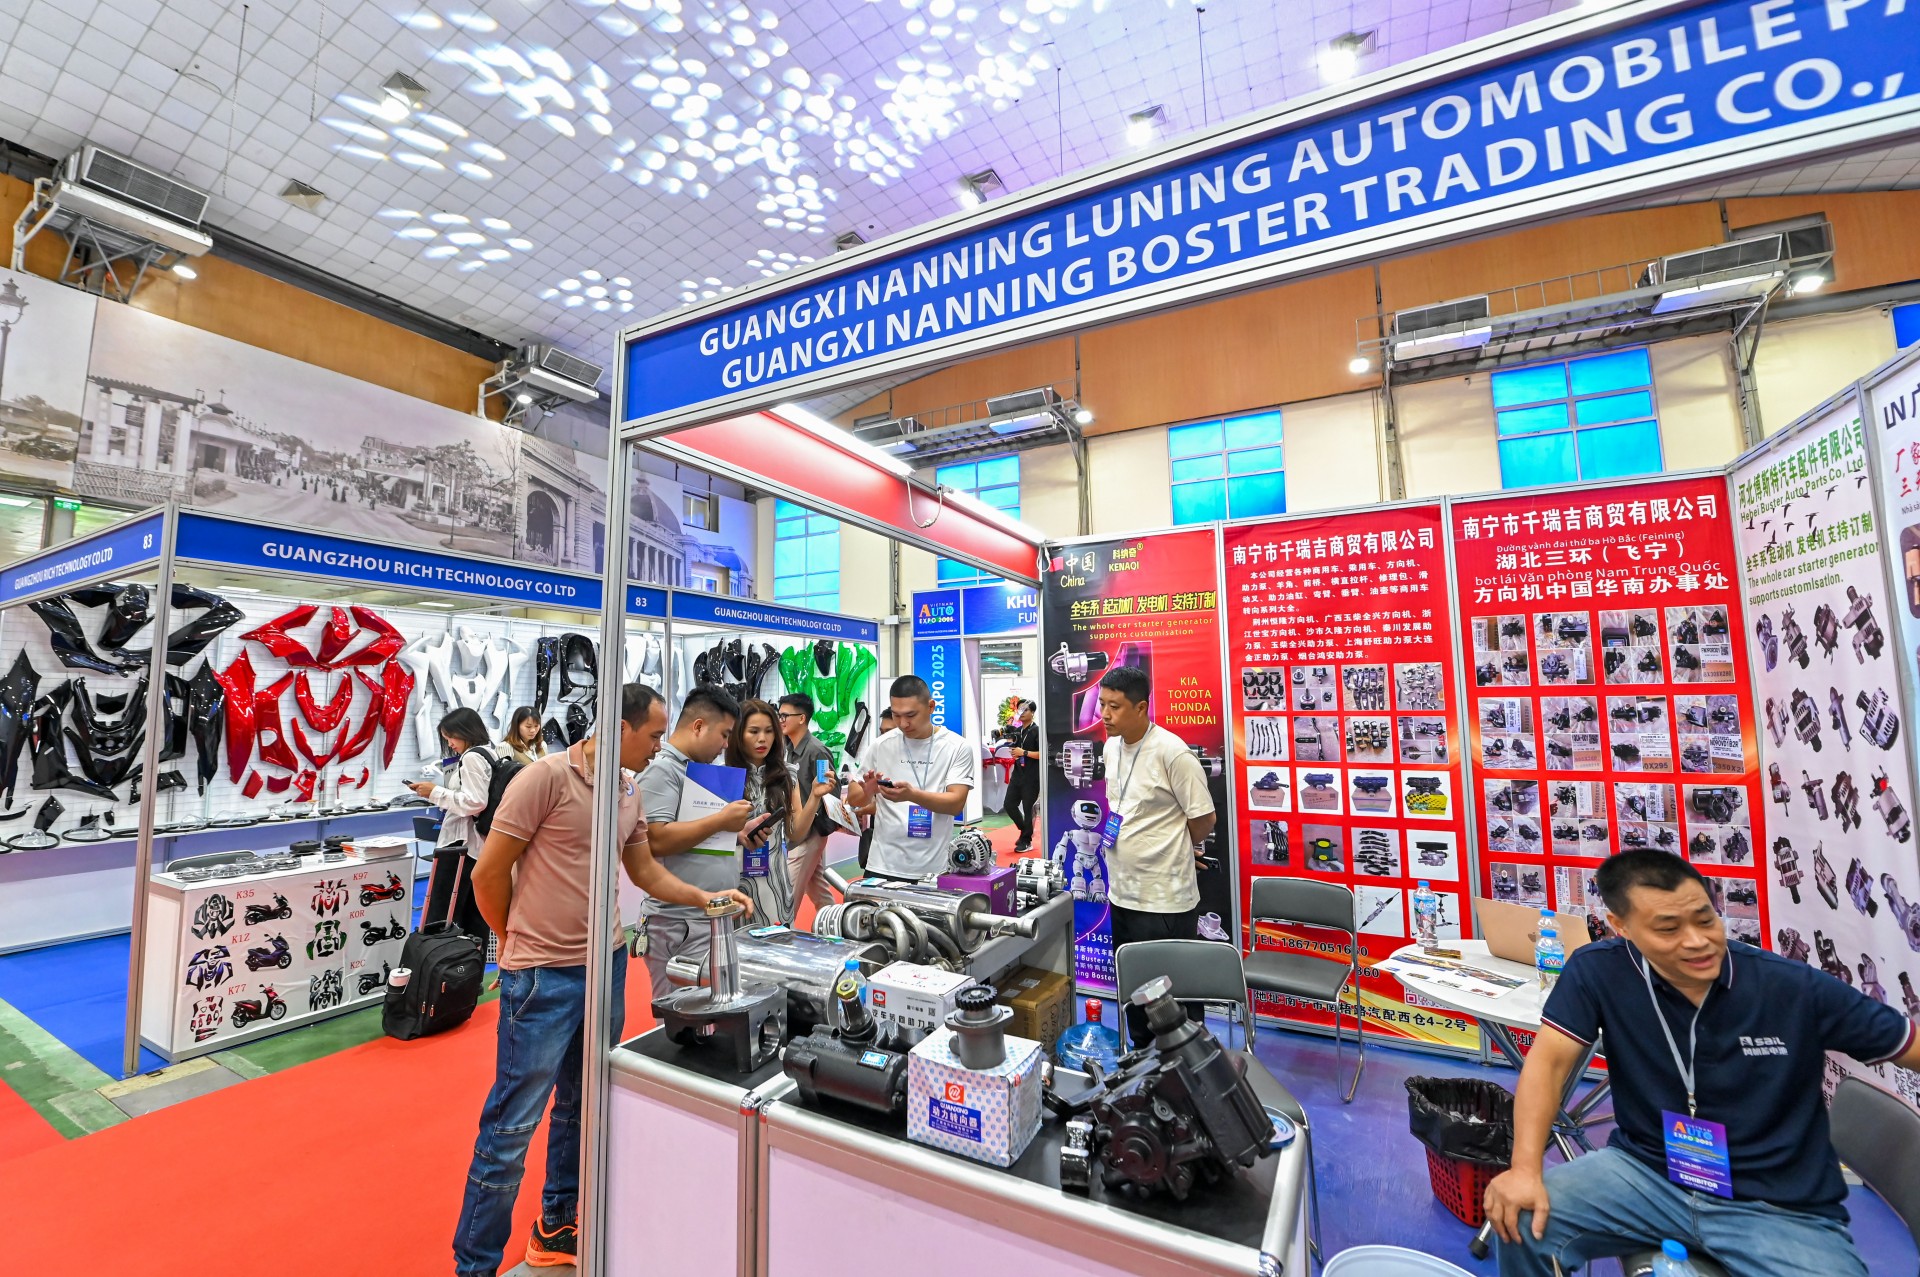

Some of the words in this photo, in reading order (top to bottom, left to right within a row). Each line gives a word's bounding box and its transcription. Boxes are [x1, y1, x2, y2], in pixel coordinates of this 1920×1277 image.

[699, 289, 846, 357] GUANGXI
[855, 221, 1053, 305] NANNING
[1064, 153, 1272, 249] LUNING
[1287, 0, 1802, 183] AUTOMOBILE
[721, 321, 875, 389] GUANGXI
[885, 258, 1095, 346] NANNING
[1106, 174, 1330, 288] BOSTER
[1340, 94, 1695, 226] TRADING
[1715, 57, 1905, 125] CO.,
[1738, 417, 1865, 508] 河北博斯特汽车配件有限公司
[1740, 502, 1760, 522] Hebei
[1760, 496, 1784, 513] Buster
[1785, 486, 1805, 502] Auto
[1805, 476, 1828, 493] Parts
[1847, 457, 1867, 474] Ltd.
[1462, 494, 1718, 540] 南宁市千瑞吉商贸有限公司
[143, 532, 153, 551] 83
[1232, 527, 1434, 566] 南宁市千瑞吉商贸有限公司
[1588, 536, 1600, 546] ba
[1638, 531, 1685, 543] (Feining)
[43, 566, 56, 581] RICH
[55, 553, 92, 577] TECHNOLOGY
[92, 551, 101, 566] CO
[100, 547, 113, 563] LTD
[261, 542, 390, 572] GUANGZHOU
[393, 561, 432, 578] RICH
[435, 567, 533, 592] TECHNOLOGY
[534, 582, 552, 594] CO
[554, 584, 576, 597] LTD
[1065, 551, 1096, 574] 中国
[1108, 561, 1140, 572] KENAQI
[1748, 575, 1759, 589] The
[1759, 570, 1782, 586] whole
[1783, 566, 1796, 579] car
[1797, 556, 1829, 574] starter
[1829, 541, 1879, 568] generator
[1060, 575, 1086, 588] China
[1475, 575, 1498, 587] bot
[1596, 567, 1628, 579] Nam
[1632, 564, 1677, 579] Trung
[1473, 572, 1730, 604] 方向机中国华南办事处
[1749, 588, 1780, 606] supports
[634, 597, 647, 607] 83
[919, 603, 954, 617] AUTO
[1006, 594, 1037, 610] KHU
[1070, 598, 1100, 618] 全车系
[1102, 596, 1134, 616] 起动机
[1136, 594, 1169, 614] 发电机
[1172, 590, 1217, 612] 支持订制
[1242, 604, 1300, 615] 转向系列大全。
[714, 607, 763, 622] GUANGZHOU
[764, 614, 780, 624] RICH
[780, 616, 823, 630] TECHNOLOGY
[822, 622, 831, 631] CO
[831, 623, 842, 632] LTD
[919, 617, 936, 625] EXPO
[1072, 624, 1087, 632] The
[1089, 622, 1115, 631] whole
[1117, 622, 1131, 630] car
[1134, 620, 1164, 629] starter
[1167, 617, 1213, 629] generator
[1089, 631, 1127, 641] supports
[1129, 628, 1194, 639] customisation
[932, 644, 945, 678] 2025
[1180, 676, 1198, 687] KIA
[1168, 689, 1212, 700] TOYOTA
[1170, 702, 1211, 713] HONDA
[1165, 714, 1216, 725] HYUNDAI
[352, 872, 368, 881] K97
[236, 889, 255, 899] K35
[1254, 933, 1368, 957] TEL:1867705160
[1081, 954, 1104, 964] Buster
[1091, 971, 1116, 982] Boster
[228, 984, 247, 996] K77
[932, 1105, 978, 1129] 动力转向器
[1673, 1121, 1714, 1141] AUTO
[1679, 1172, 1719, 1190] EXHIBITOR
